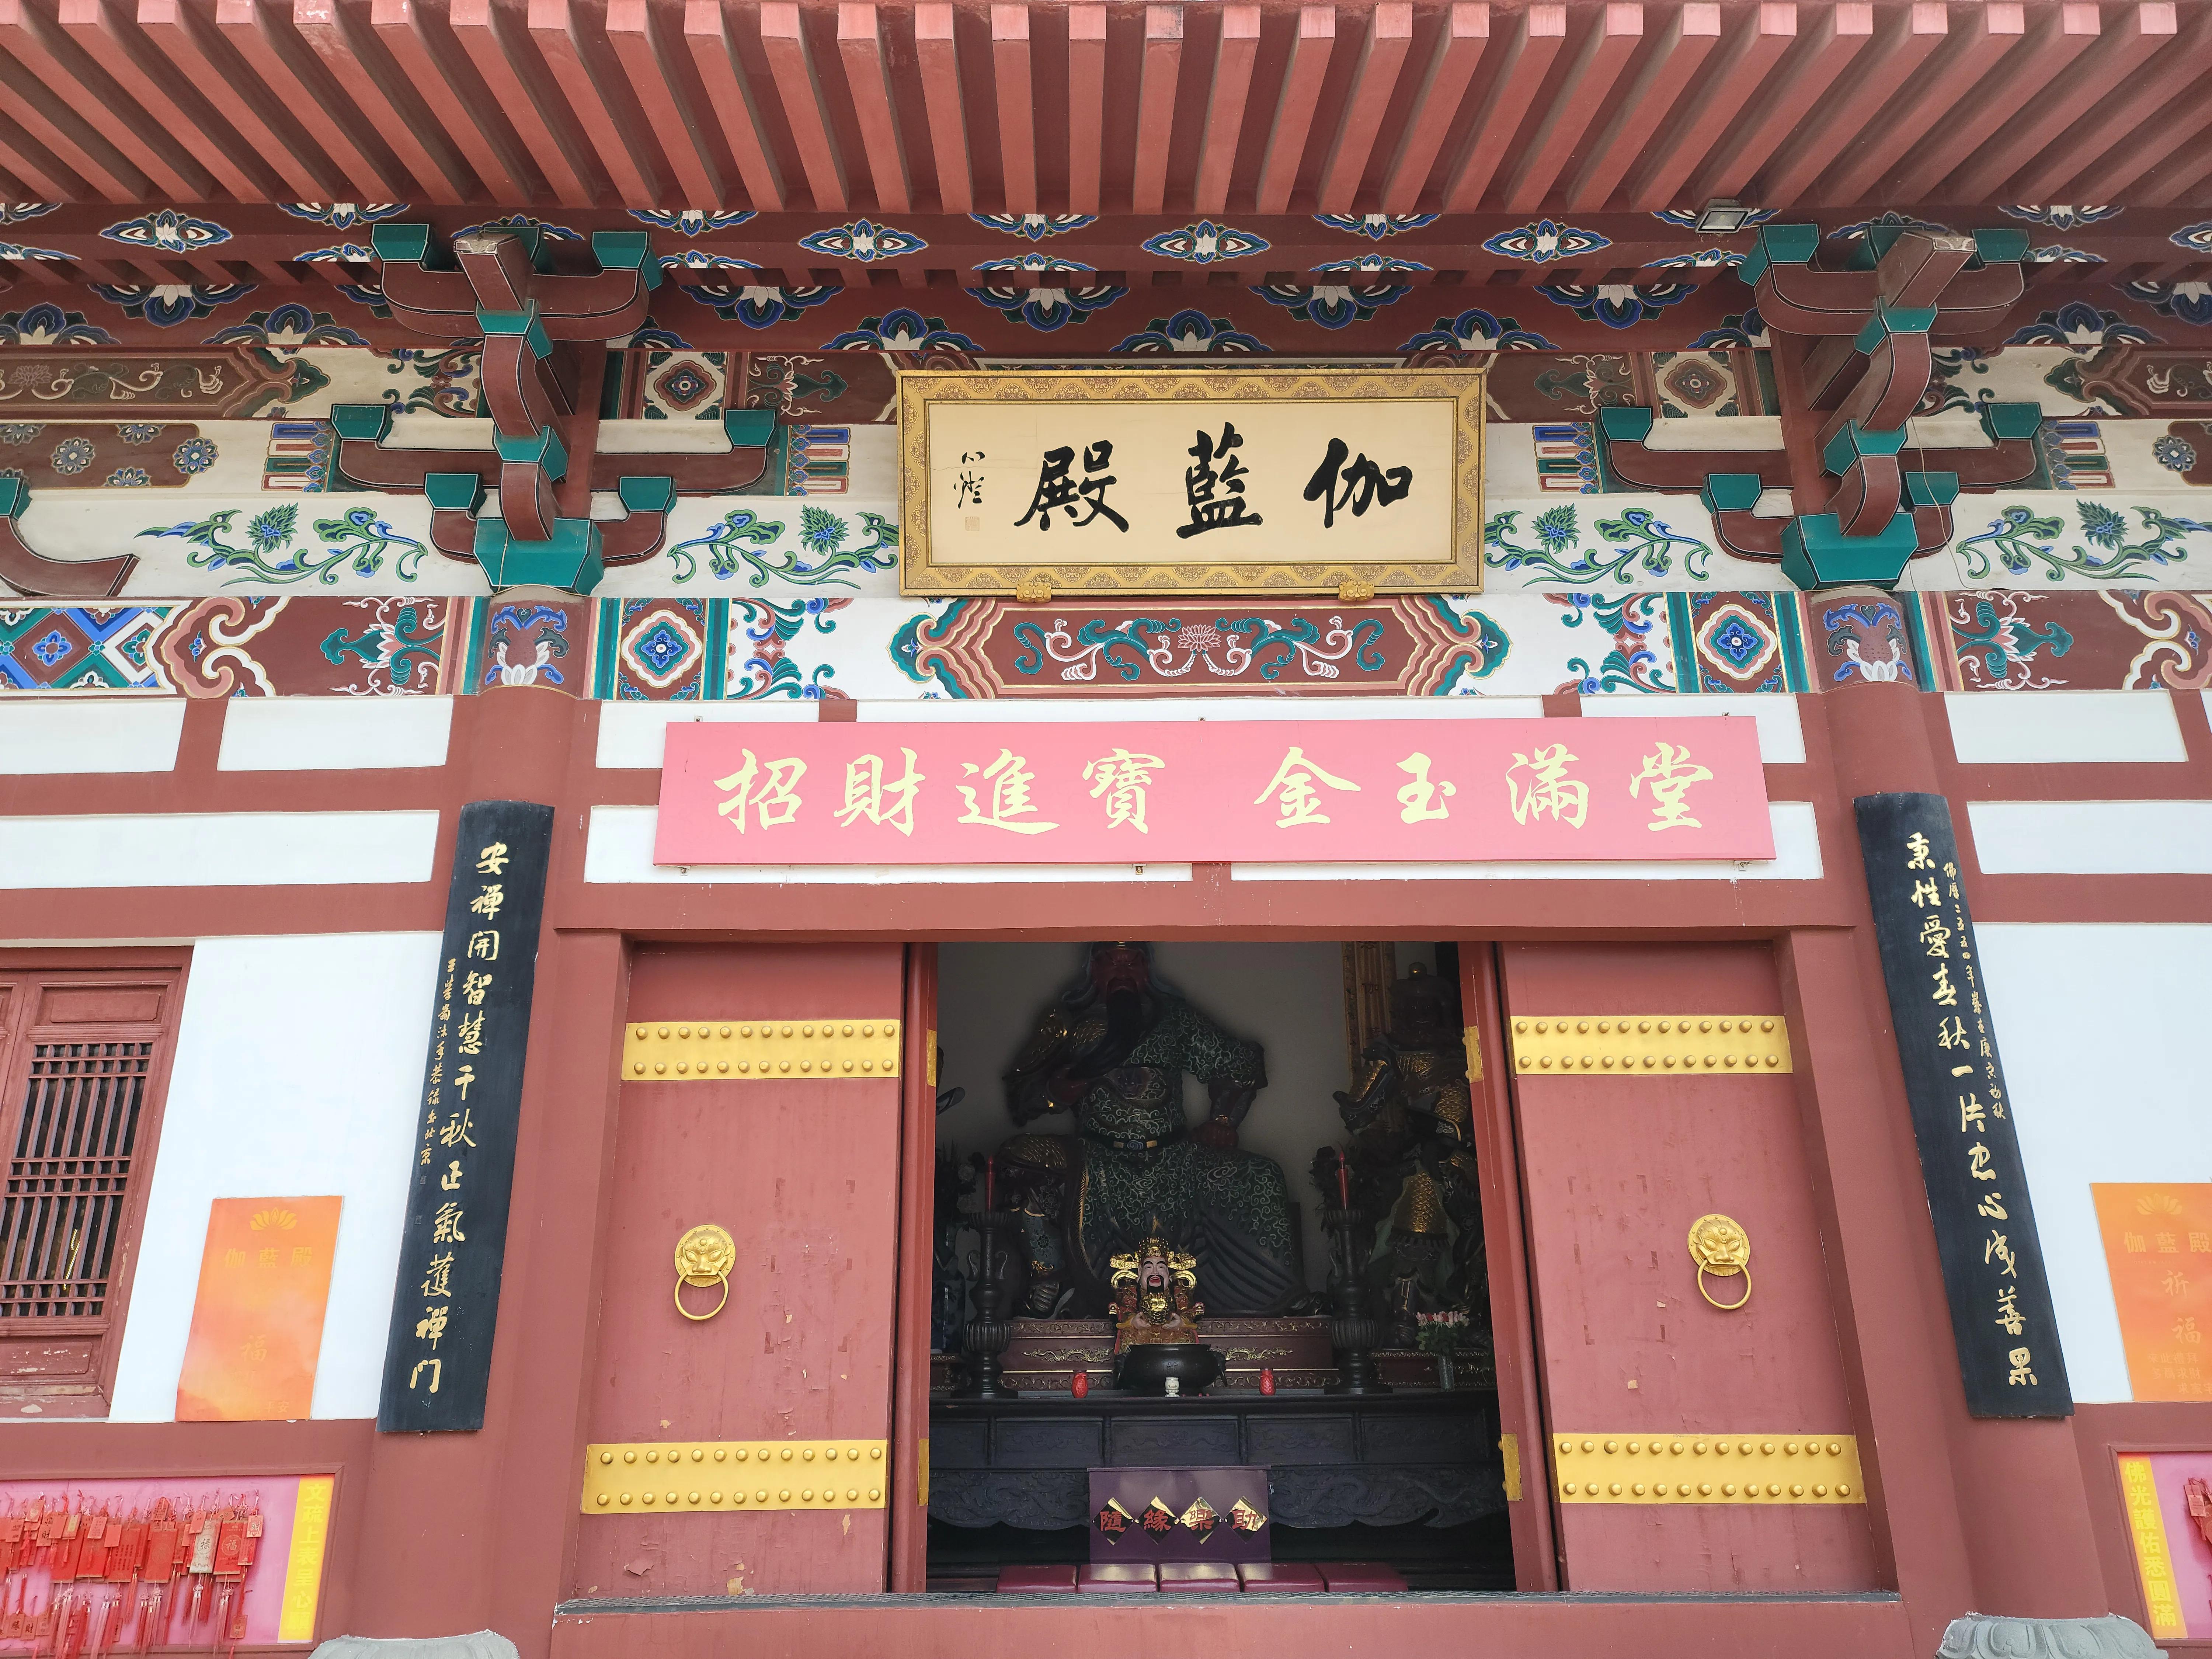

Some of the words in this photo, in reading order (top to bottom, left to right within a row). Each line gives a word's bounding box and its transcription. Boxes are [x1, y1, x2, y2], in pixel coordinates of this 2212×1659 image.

[713, 748, 1165, 837] 招財進寶
[1253, 741, 1714, 832] 金玉滿堂
[225, 1247, 312, 1269] 伽藍殿
[2124, 1231, 2212, 1254] 伽藍殿
[2161, 1269, 2201, 1345] 祈福
[2125, 1461, 2177, 1627] 佛光護佑悉圓滿
